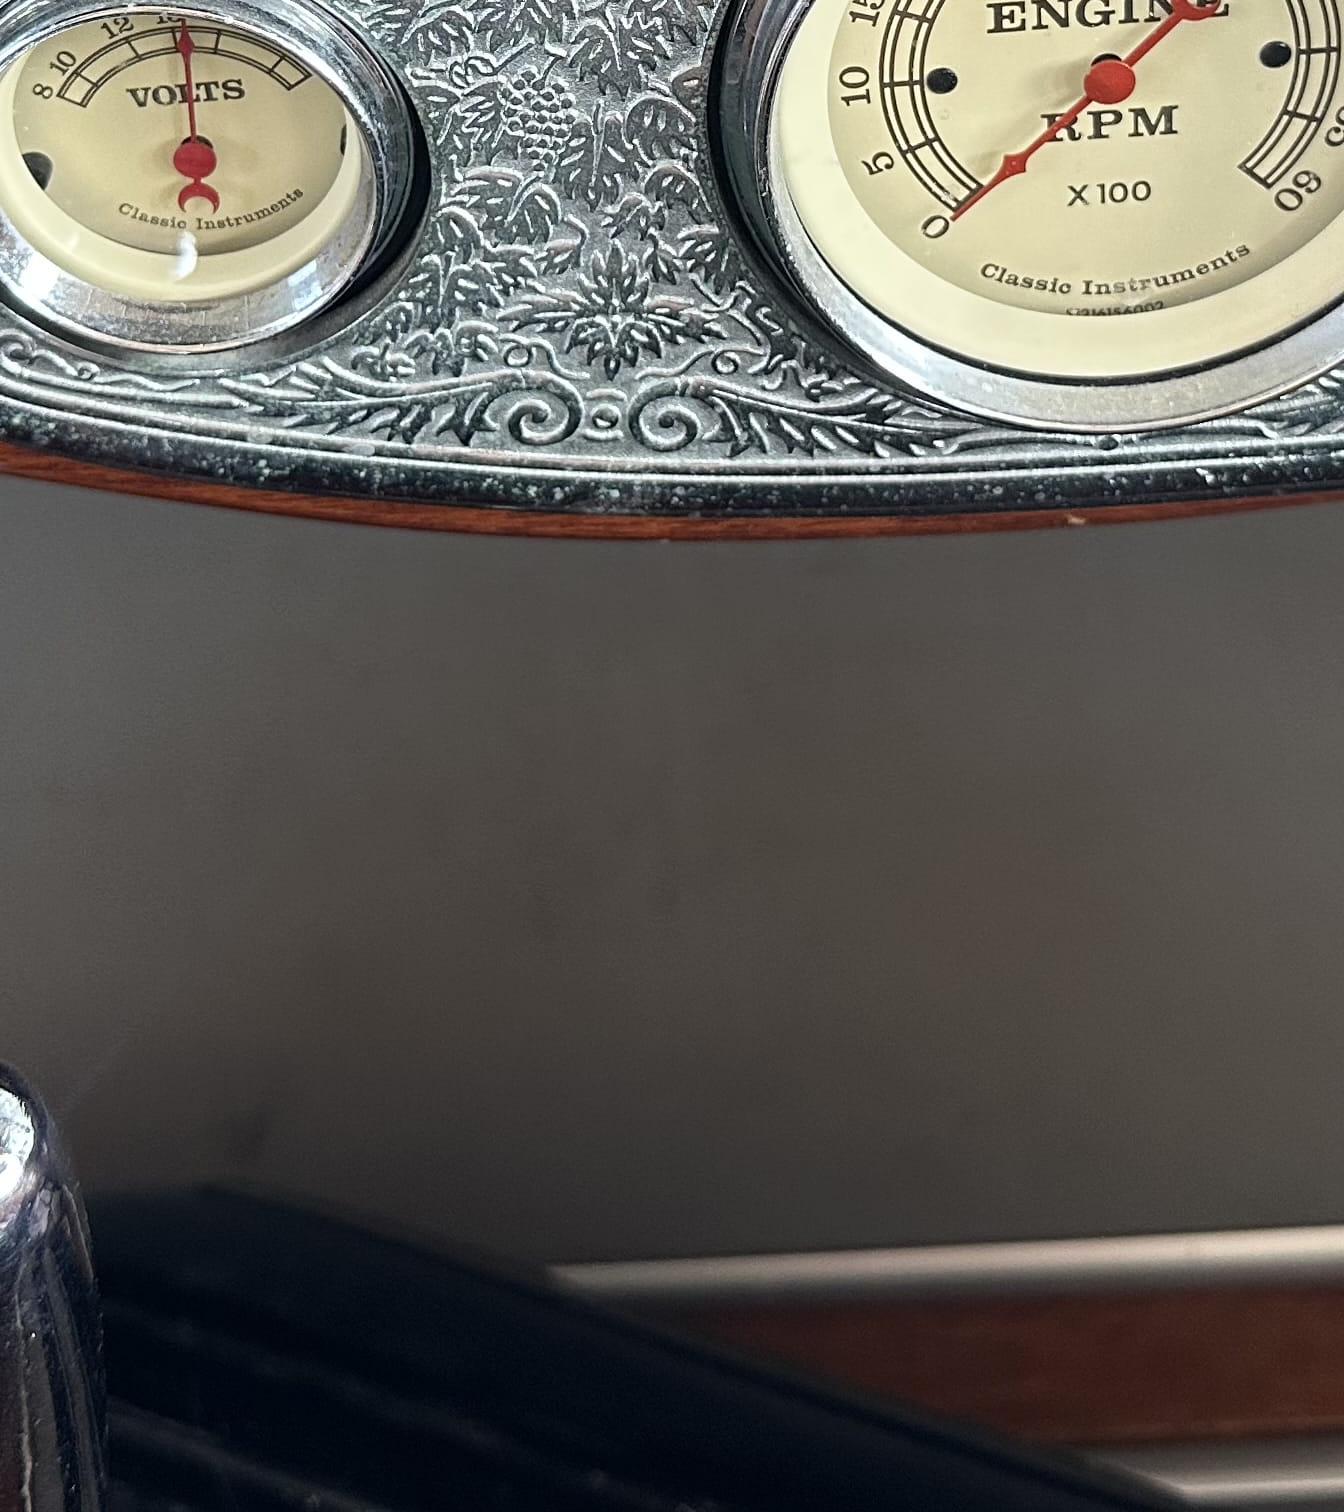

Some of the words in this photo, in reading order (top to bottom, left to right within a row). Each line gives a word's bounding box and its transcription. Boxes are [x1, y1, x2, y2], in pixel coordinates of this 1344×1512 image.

[32, 82, 54, 100] 8
[49, 50, 76, 75] 10
[101, 16, 134, 39] 12
[126, 78, 246, 108] VOLTS
[838, 65, 872, 106] 10
[1041, 105, 1179, 143] RPM
[861, 149, 895, 178] 5
[118, 202, 187, 230] Classic
[195, 187, 304, 231] Instruments
[1273, 169, 1323, 214] 60
[920, 213, 949, 240] 0
[981, 262, 1072, 295] Classic
[1081, 242, 1251, 295] Instruments
